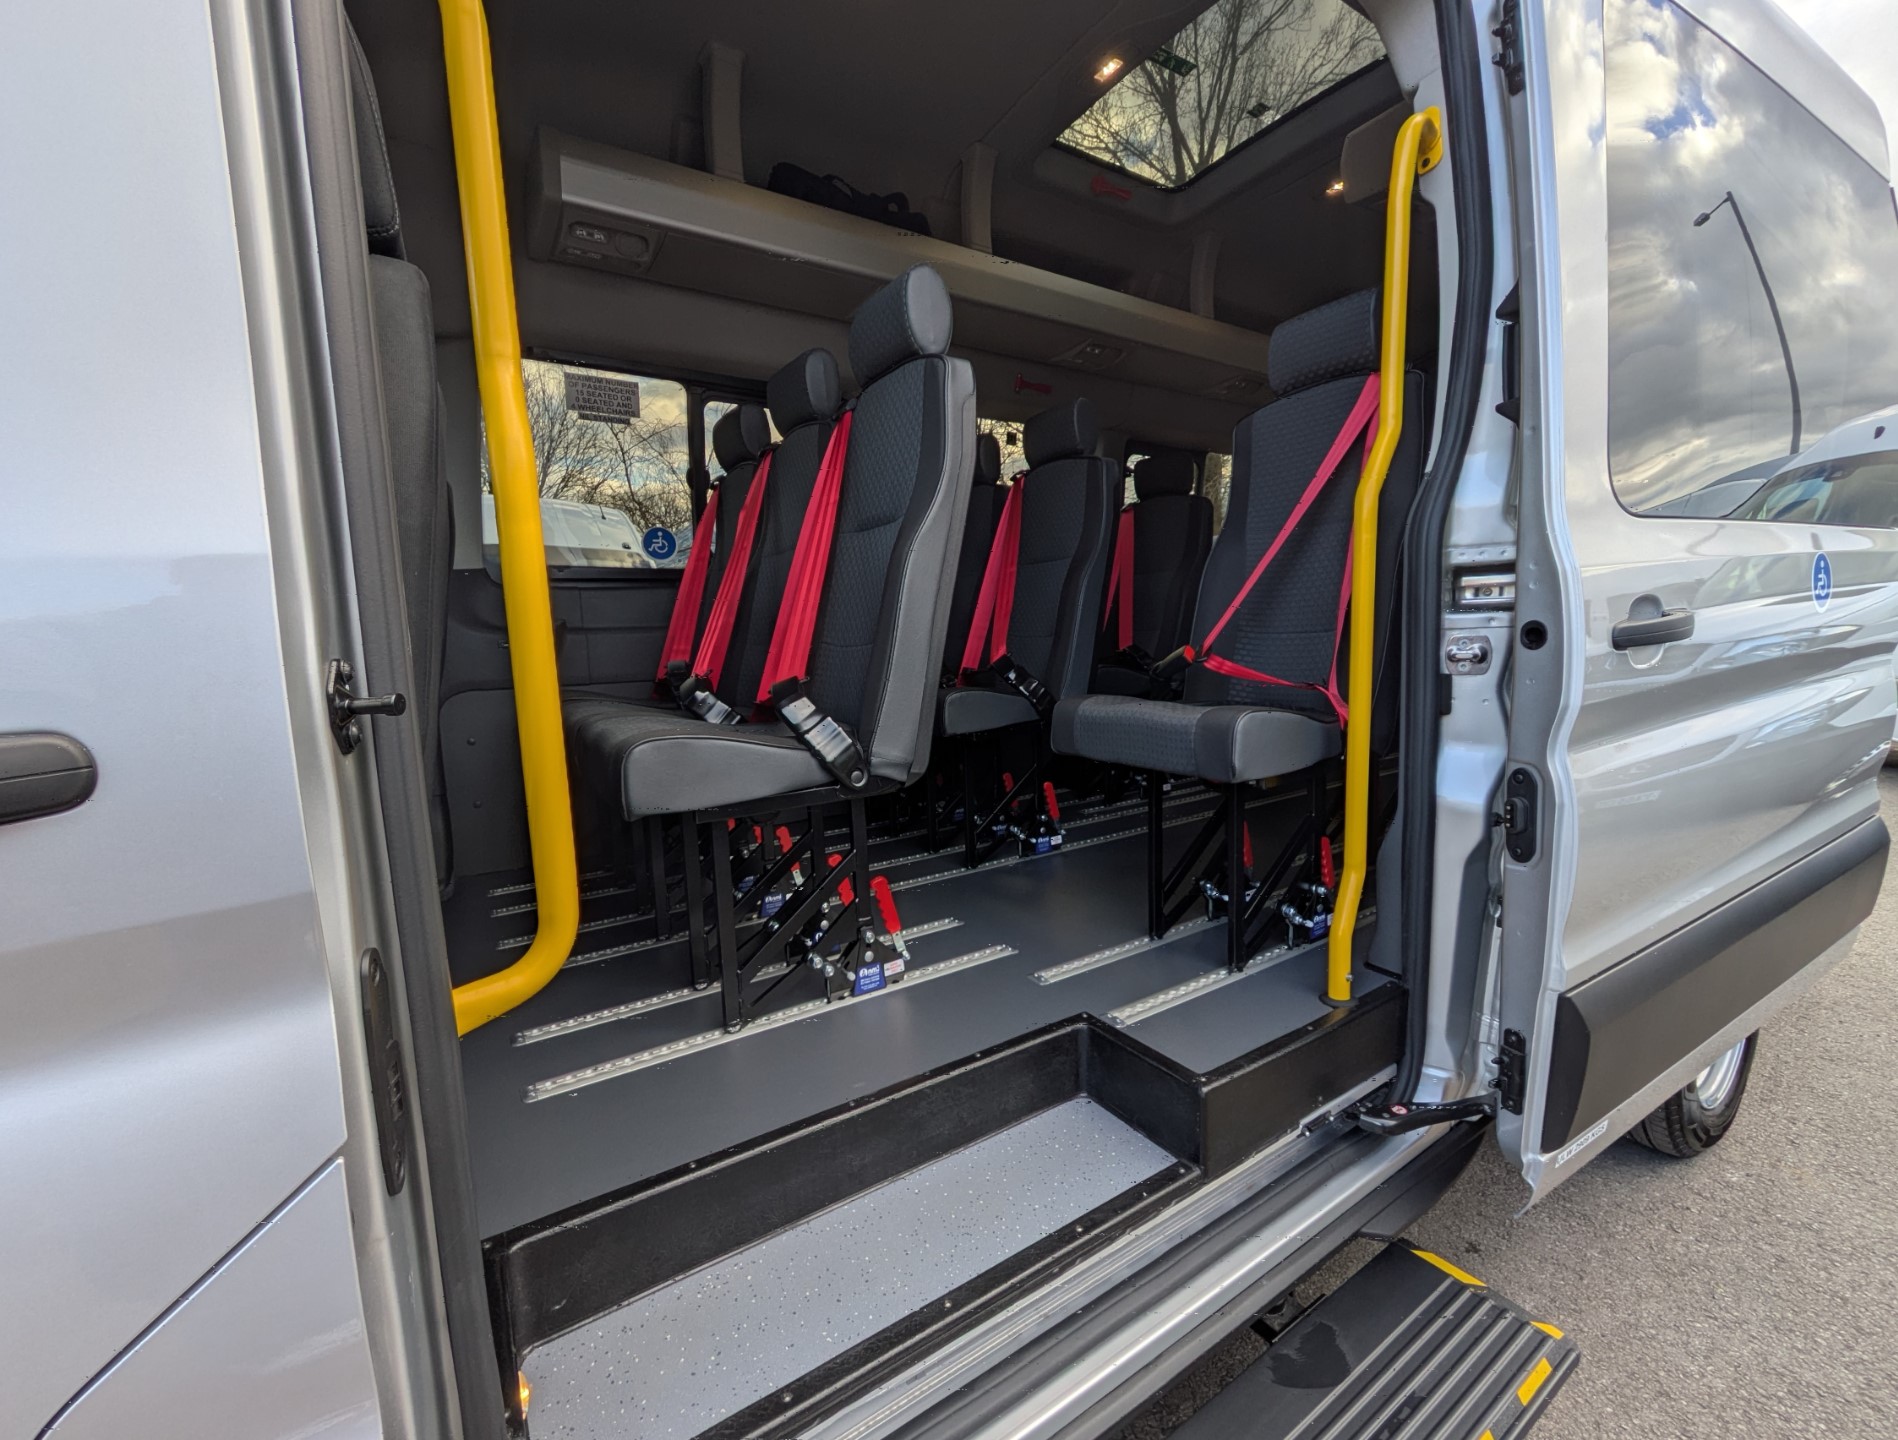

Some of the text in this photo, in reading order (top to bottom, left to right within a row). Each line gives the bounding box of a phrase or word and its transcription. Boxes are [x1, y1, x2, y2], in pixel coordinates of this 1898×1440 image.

[566, 374, 638, 389] MAXIMUM NUMBER
[581, 382, 636, 396] PASSENGERS
[586, 390, 618, 401] SEATED
[582, 397, 615, 407] SEATED
[577, 405, 636, 417] WHEELCHAIRS
[592, 415, 630, 424] STANDING
